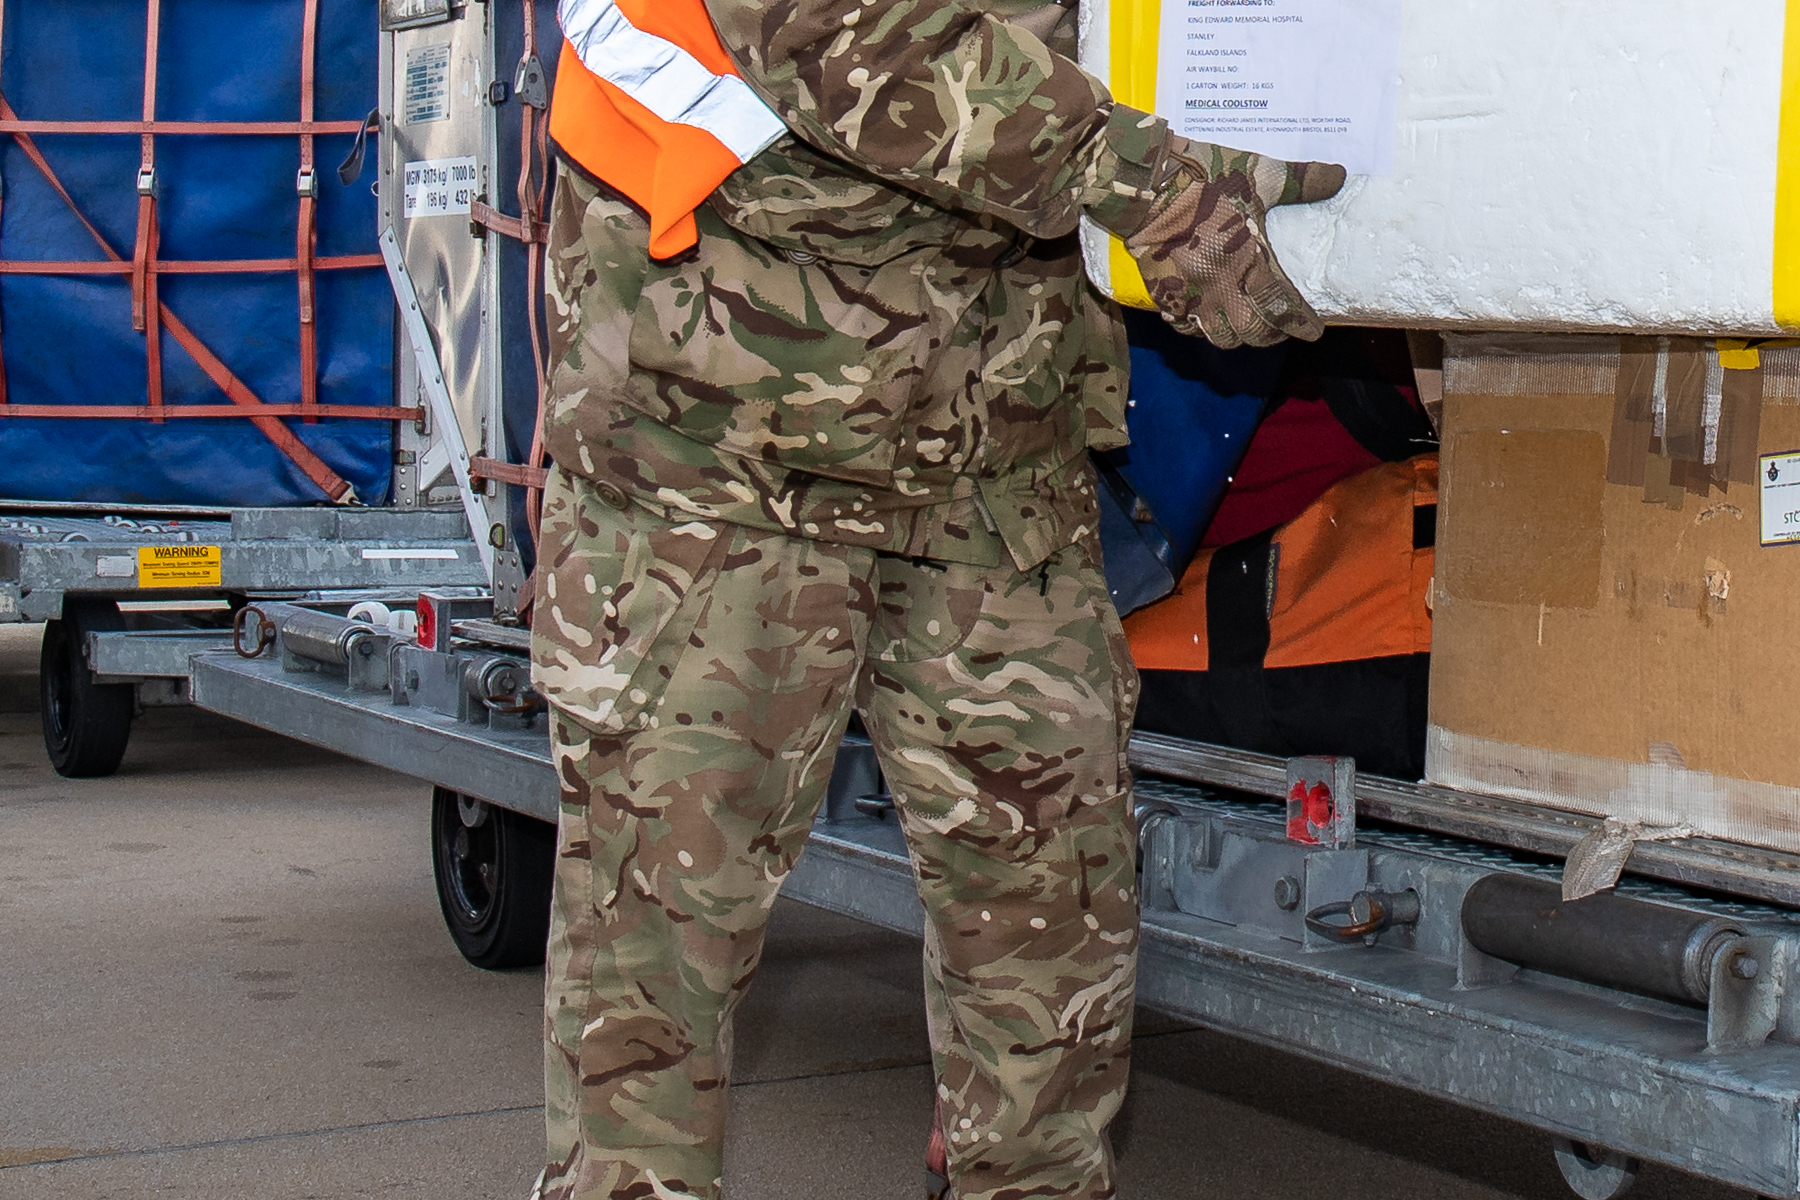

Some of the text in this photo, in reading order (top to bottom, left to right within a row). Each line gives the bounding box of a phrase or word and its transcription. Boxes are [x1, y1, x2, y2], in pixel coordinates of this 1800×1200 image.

[1188, 0, 1216, 7] FREIGHT
[1272, 15, 1303, 23] HOSPITAL
[1221, 82, 1249, 90] WEIGHT:
[1185, 99, 1269, 108] MEDICAL COOLSTOW
[423, 168, 437, 184] 3175
[452, 165, 468, 181] 7000
[455, 188, 468, 205] 432
[154, 547, 209, 558] WARNING
